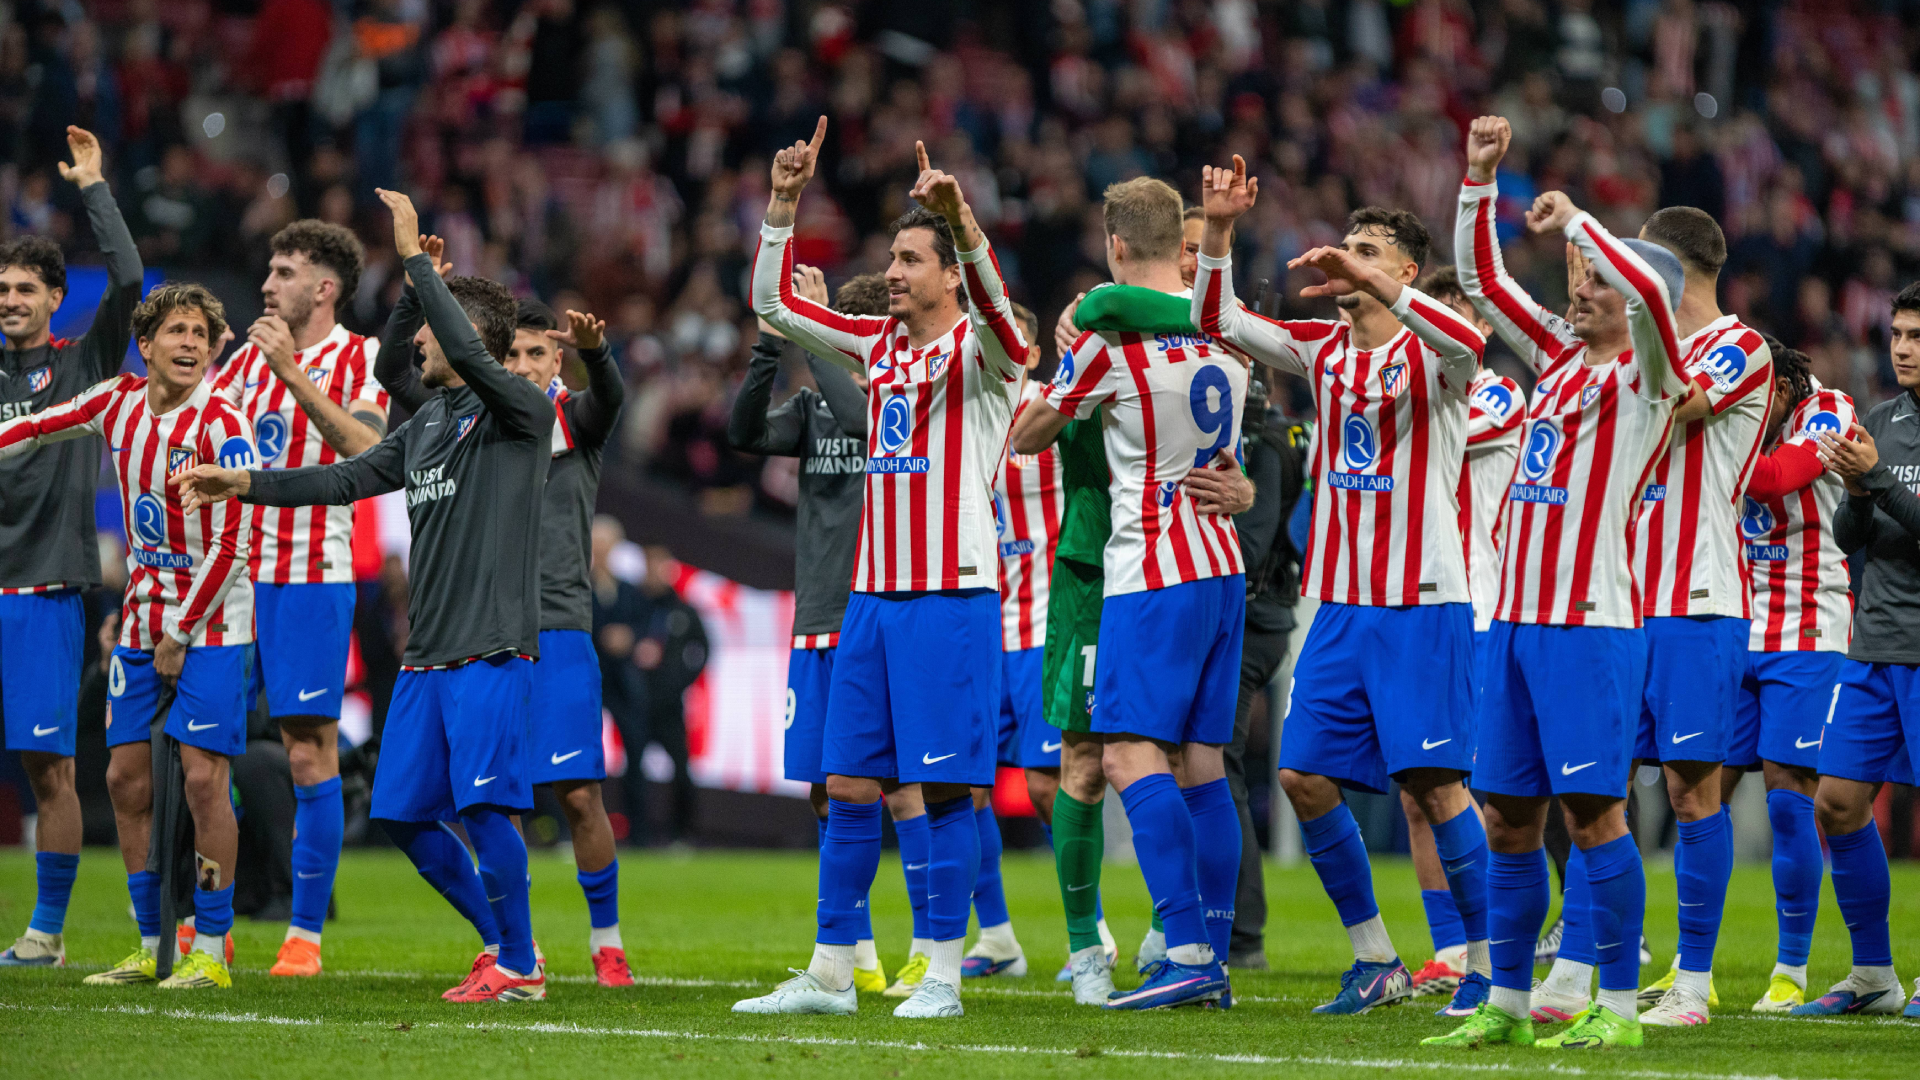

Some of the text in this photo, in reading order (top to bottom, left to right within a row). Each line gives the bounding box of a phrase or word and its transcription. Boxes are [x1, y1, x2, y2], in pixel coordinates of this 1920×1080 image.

[1699, 361, 1729, 392] kraken
[1190, 364, 1234, 468] 9
[817, 438, 860, 456] VISIT
[903, 458, 927, 471] AIR
[1887, 464, 1920, 482] VISI
[1329, 471, 1391, 490] RIYADH AIR
[1541, 488, 1565, 503] AIR
[1649, 486, 1665, 499] AIR
[166, 555, 191, 567] AIR
[1761, 546, 1786, 560] AIR
[1080, 644, 1097, 687] 1
[109, 654, 127, 697] 0
